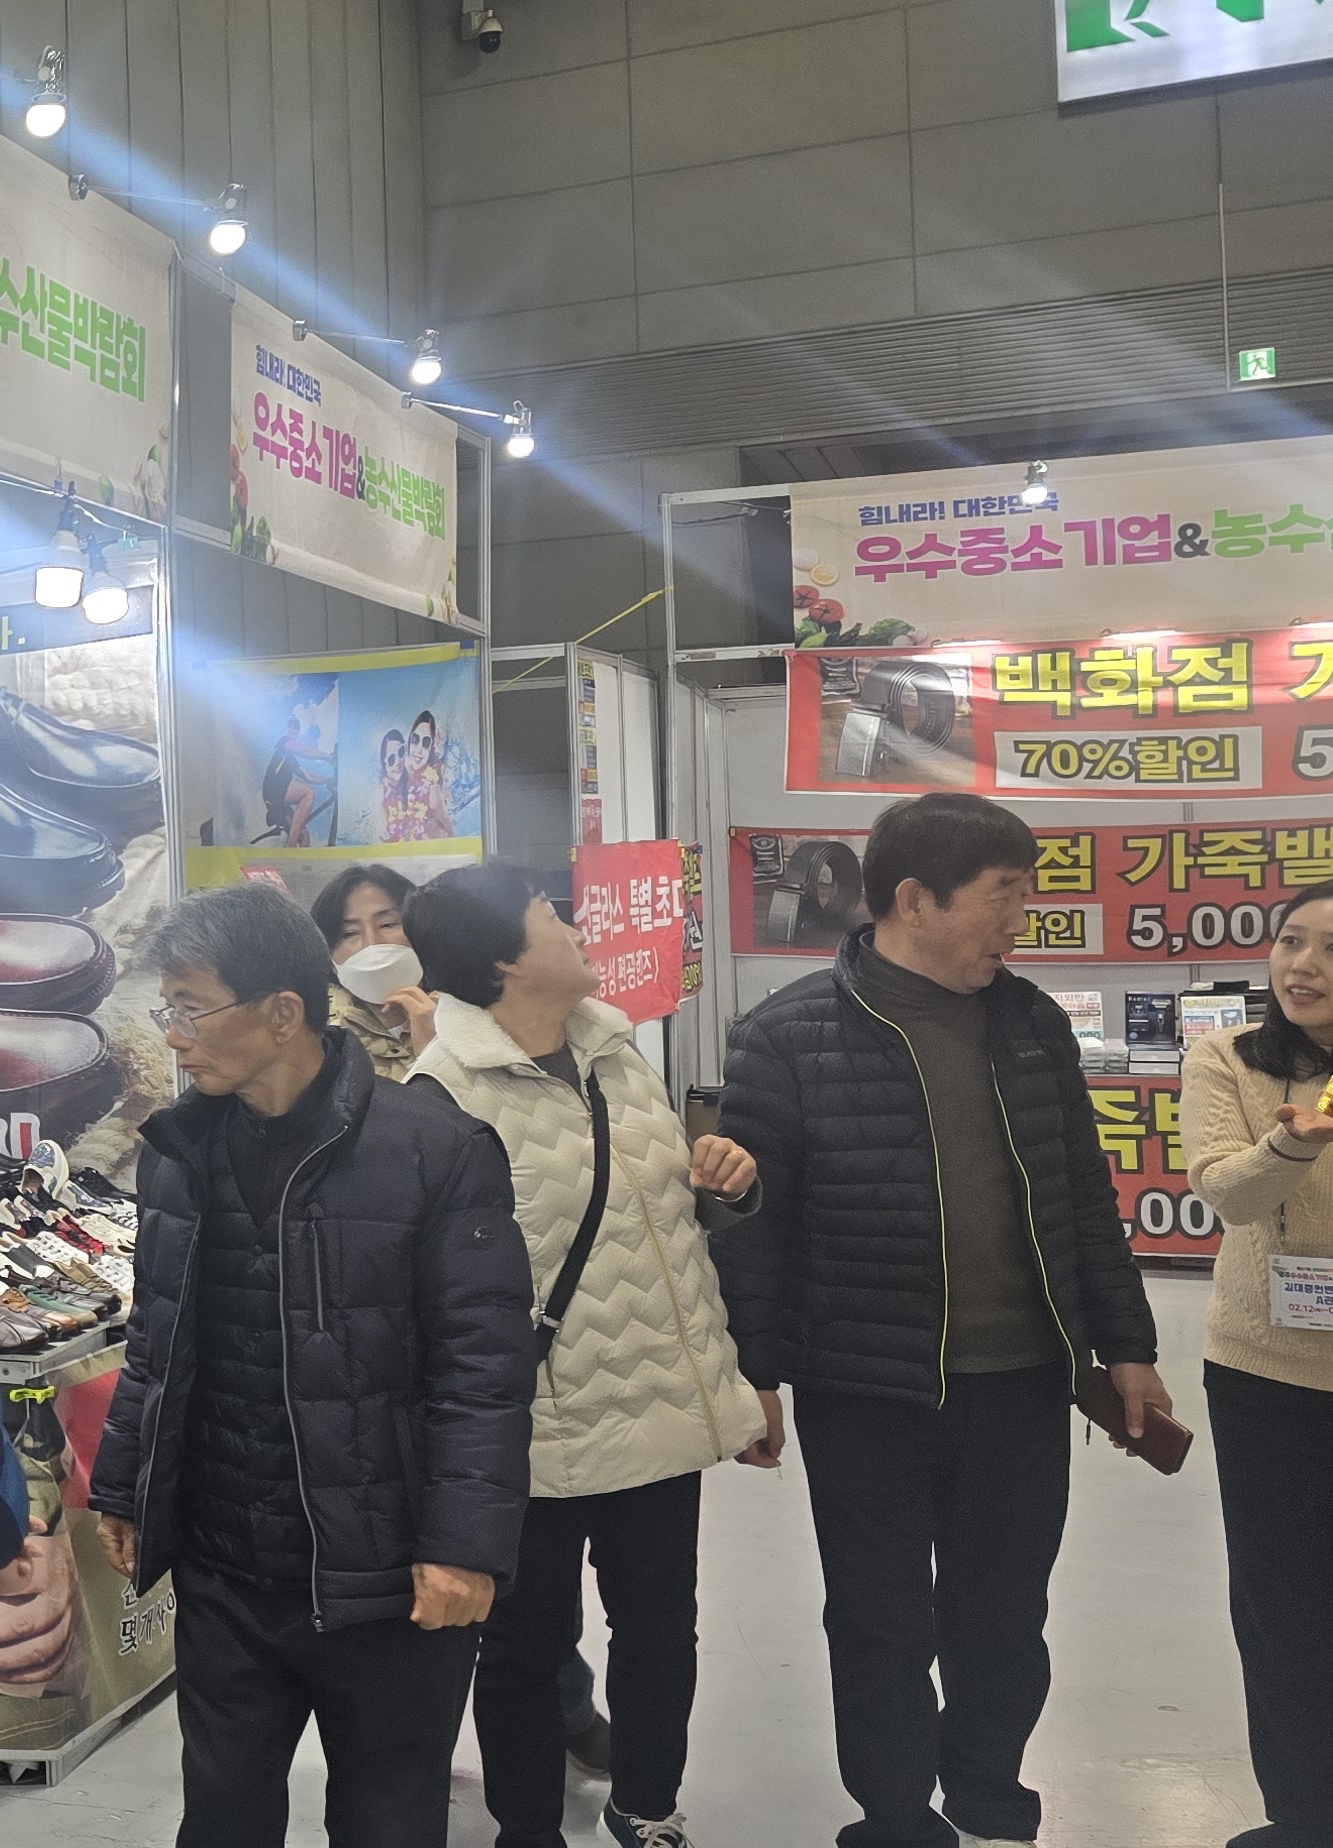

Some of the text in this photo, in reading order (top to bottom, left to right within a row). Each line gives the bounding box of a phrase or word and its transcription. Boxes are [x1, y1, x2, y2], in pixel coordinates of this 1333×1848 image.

[255, 344, 322, 407] 힘내라! 대한민국
[858, 492, 1059, 527] 힘내라! 대한민국
[854, 503, 1333, 583] 우수중소기업&농수
[993, 640, 1250, 716] 백화점
[1017, 735, 1236, 781] 70%할인
[1035, 835, 1093, 892] 점
[1130, 906, 1287, 953] 5,00
